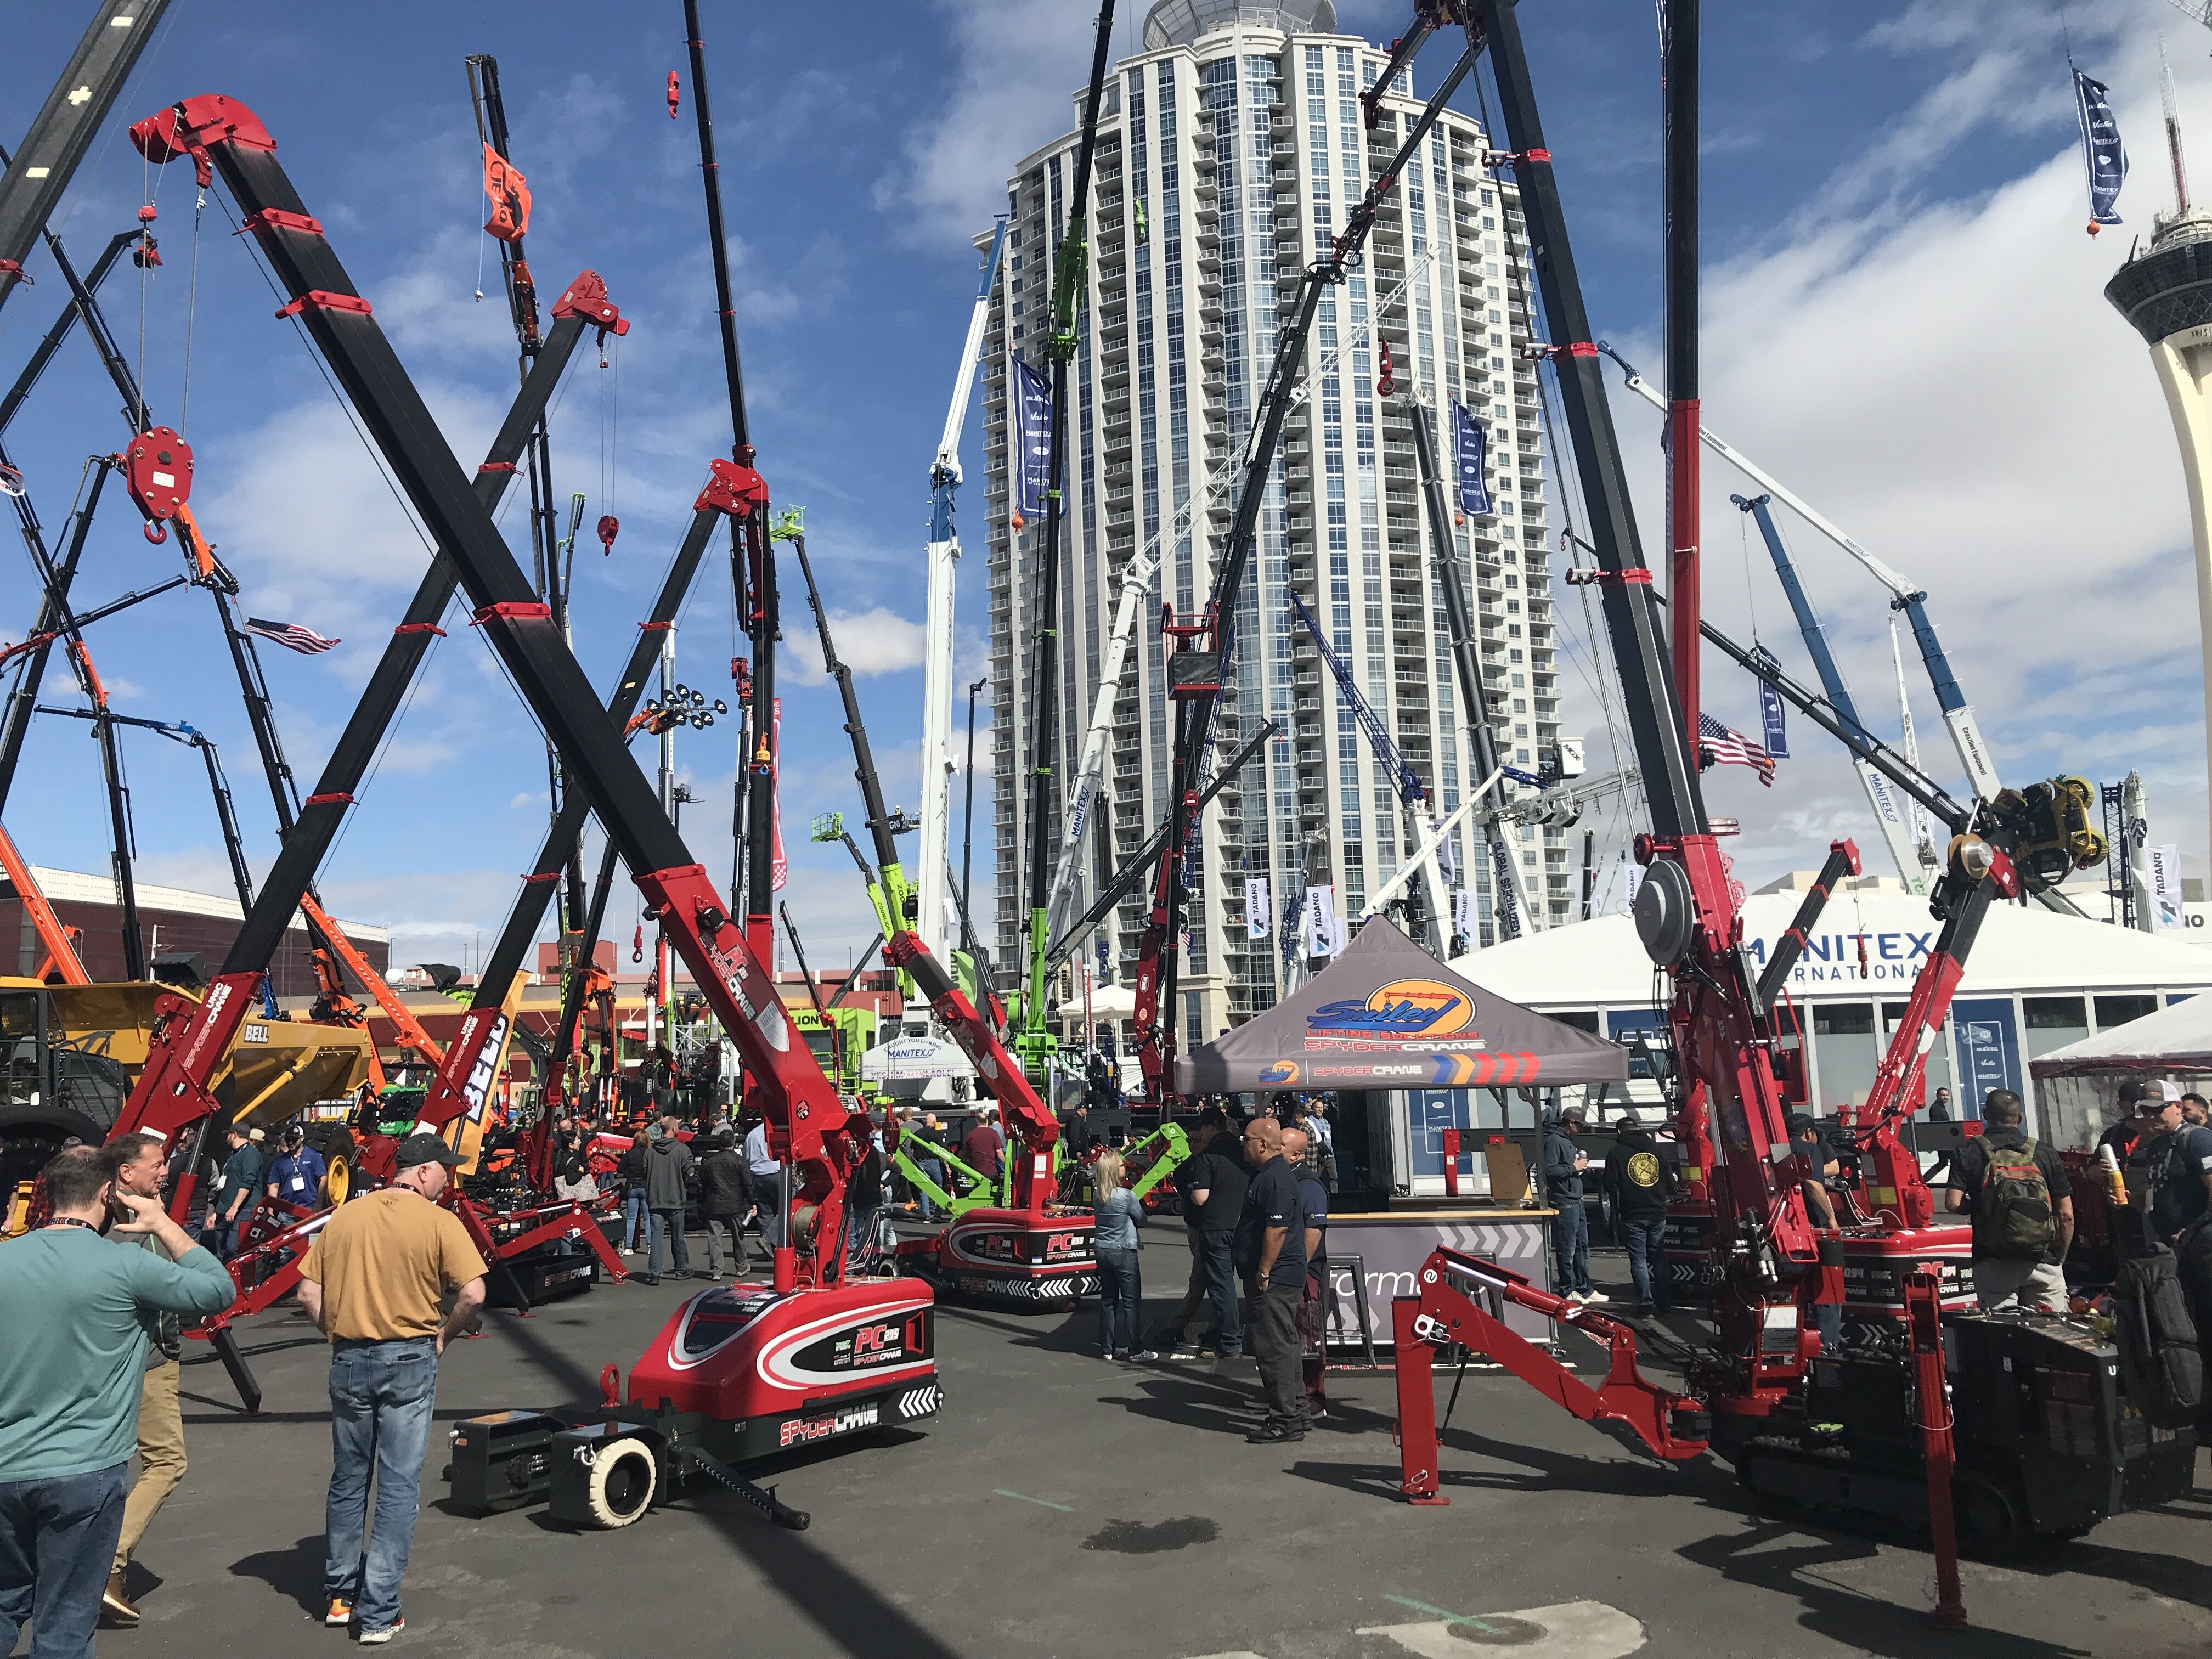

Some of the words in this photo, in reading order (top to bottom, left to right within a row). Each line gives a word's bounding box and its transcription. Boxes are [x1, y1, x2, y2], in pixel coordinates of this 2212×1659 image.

[1845, 538, 1865, 554] MANITEX
[1962, 727, 1976, 751] Coastline
[1972, 750, 1987, 775] Equipment
[1869, 773, 1894, 817] MANITEX
[1071, 794, 1087, 837] MANITEX
[1493, 842, 1508, 877] GLOBAL
[2154, 852, 2165, 895] TADANO
[877, 901, 891, 932] ZOOMLION
[1312, 892, 1322, 928] TADANO
[1500, 877, 1521, 933] SPECIALIZED
[206, 982, 223, 1008] UNIC
[461, 1015, 472, 1035] UNIC
[1306, 996, 1460, 1032] Smiley
[183, 984, 233, 1069] SPYDERCRANE
[245, 1025, 269, 1042] BELL
[1306, 1029, 1373, 1039] LIFTING
[1380, 1031, 1479, 1040] SOLUTIONS
[884, 1039, 906, 1052] CAUGHT
[888, 1048, 926, 1058] MANITEX
[1304, 1040, 1486, 1051] SPYDERCRANE
[1314, 1065, 1423, 1076] SPYDERCRANE
[1047, 1233, 1074, 1252] PC
[1046, 1251, 1086, 1260] SPYDERCRANE
[1426, 1271, 1436, 1282] 2
[854, 1323, 888, 1354] PC
[884, 1328, 900, 1342] 295
[854, 1349, 902, 1367] SPYDERCRANE
[780, 1401, 878, 1447] SPYDERCRANE
